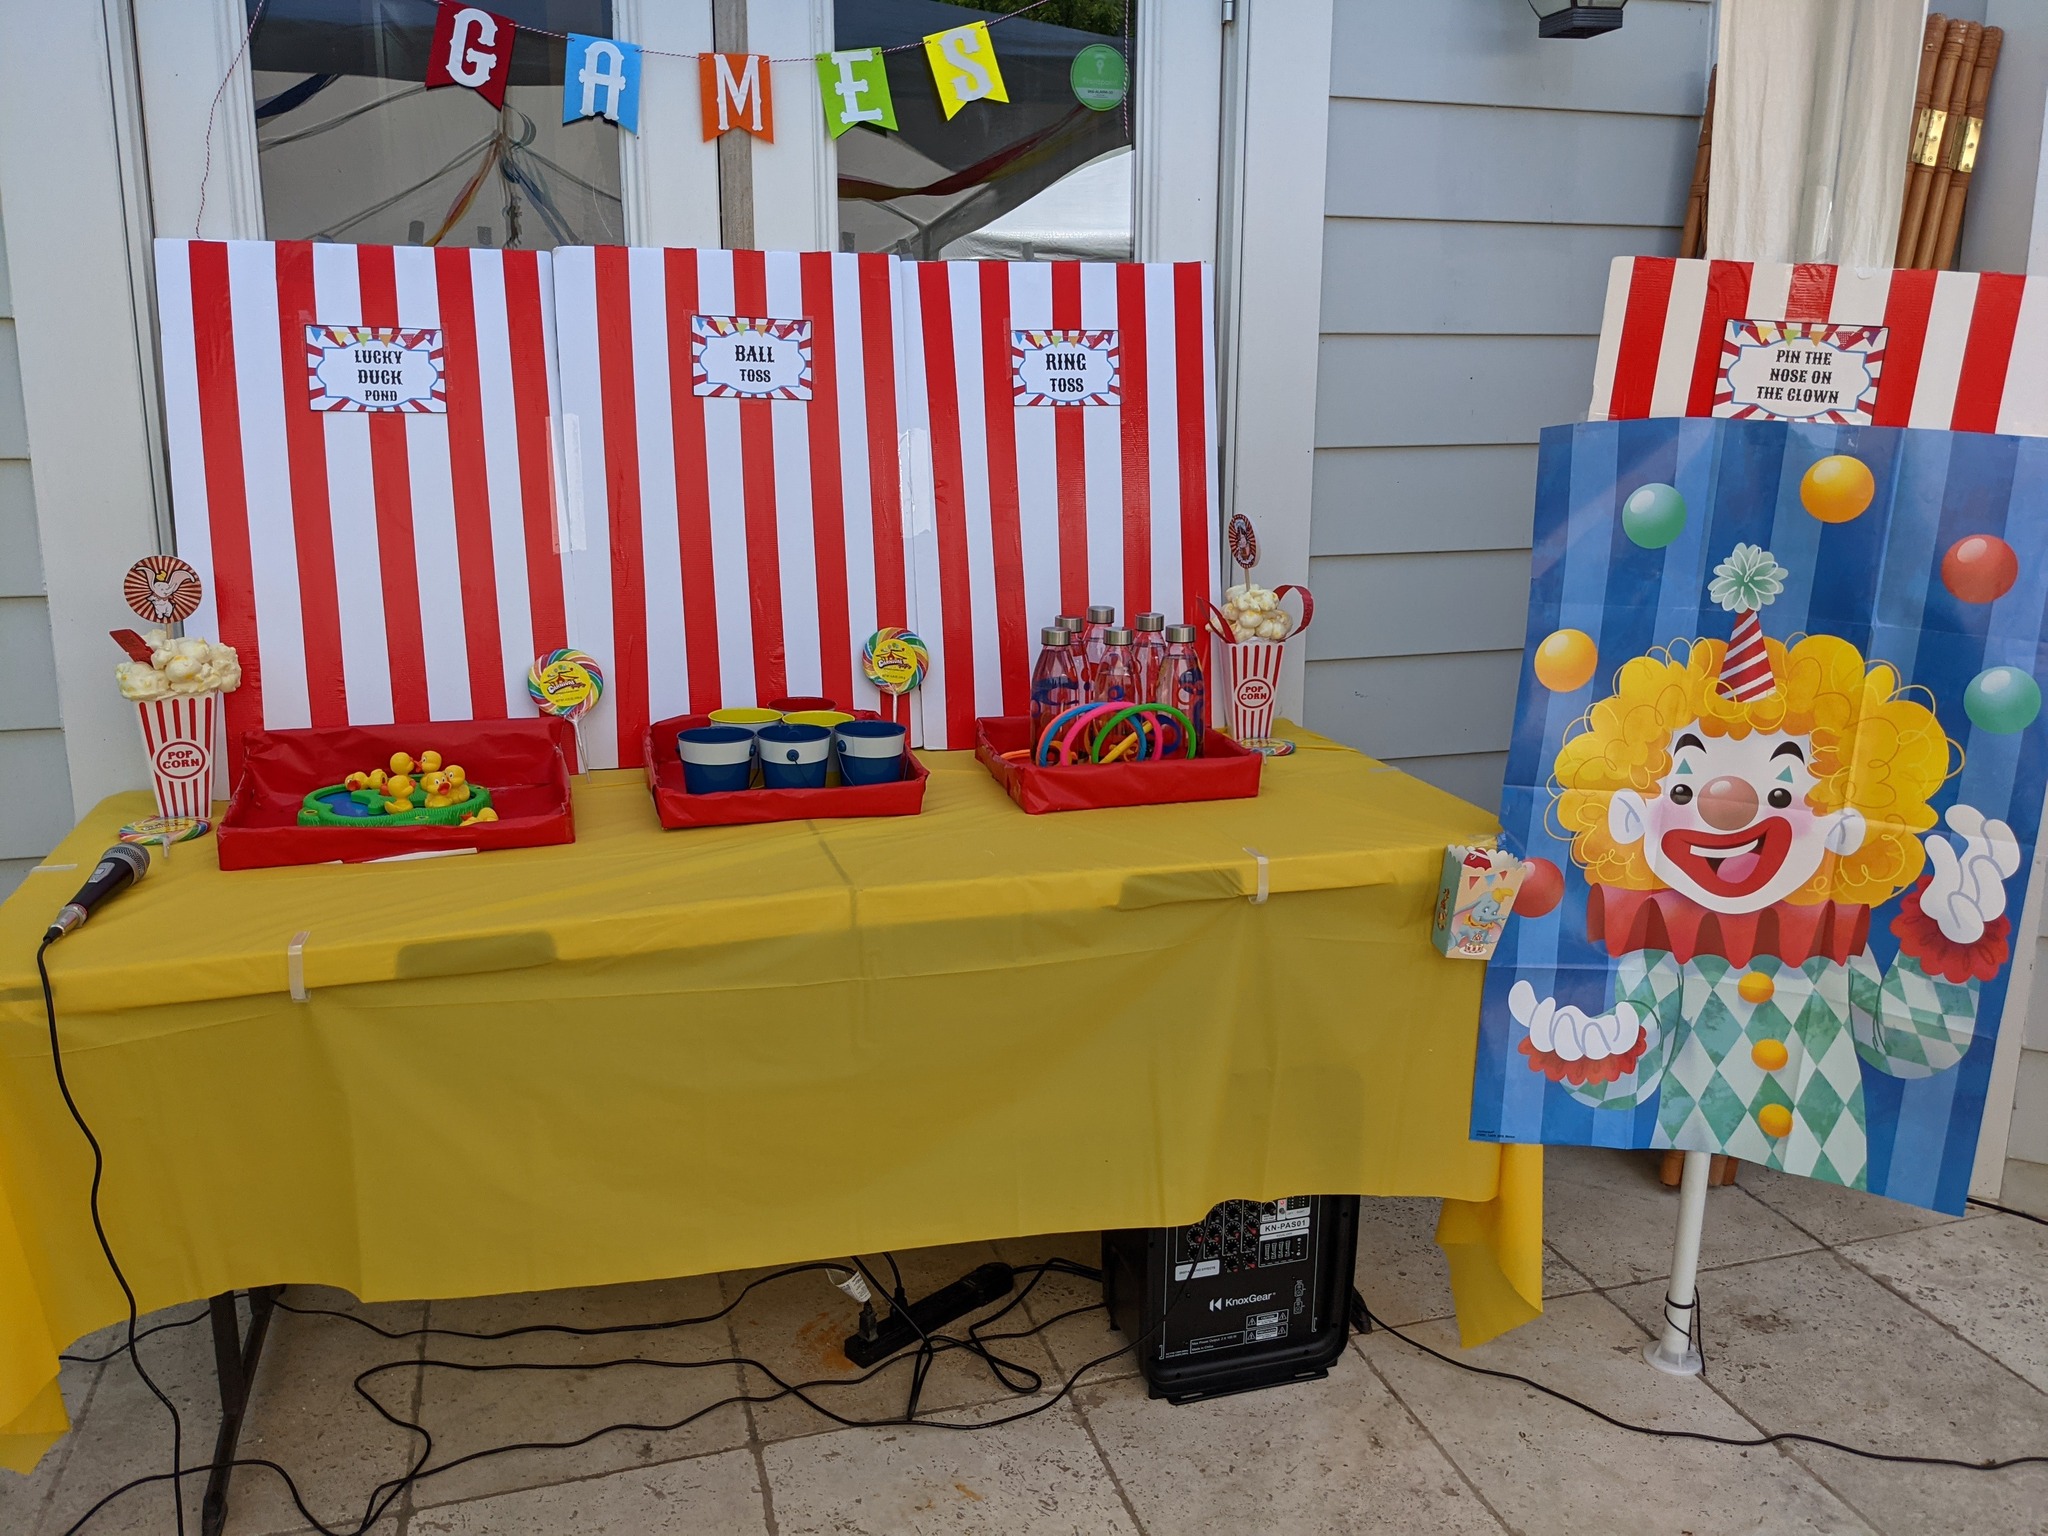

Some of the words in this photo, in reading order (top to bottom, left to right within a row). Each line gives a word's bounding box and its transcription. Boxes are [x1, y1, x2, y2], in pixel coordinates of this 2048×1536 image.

[447, 8, 993, 131] GAMES
[355, 350, 403, 365] LUCKY
[735, 345, 775, 363] BALL
[1046, 353, 1087, 370] RING
[1776, 350, 1800, 364] PIN
[1805, 351, 1832, 366] THE
[358, 370, 403, 385] DUCK
[739, 369, 771, 382] TOSS
[1769, 368, 1808, 384] NOSE
[1811, 371, 1832, 384] ON
[1050, 378, 1084, 392] TOSS
[365, 390, 397, 401] POND
[1757, 386, 1784, 400] THE
[1787, 388, 1839, 404] CLOWN
[168, 750, 193, 760] POP
[162, 759, 200, 769] CORN
[1264, 1219, 1306, 1232] KN-PAS01
[1225, 1292, 1273, 1307] KnoxGear
